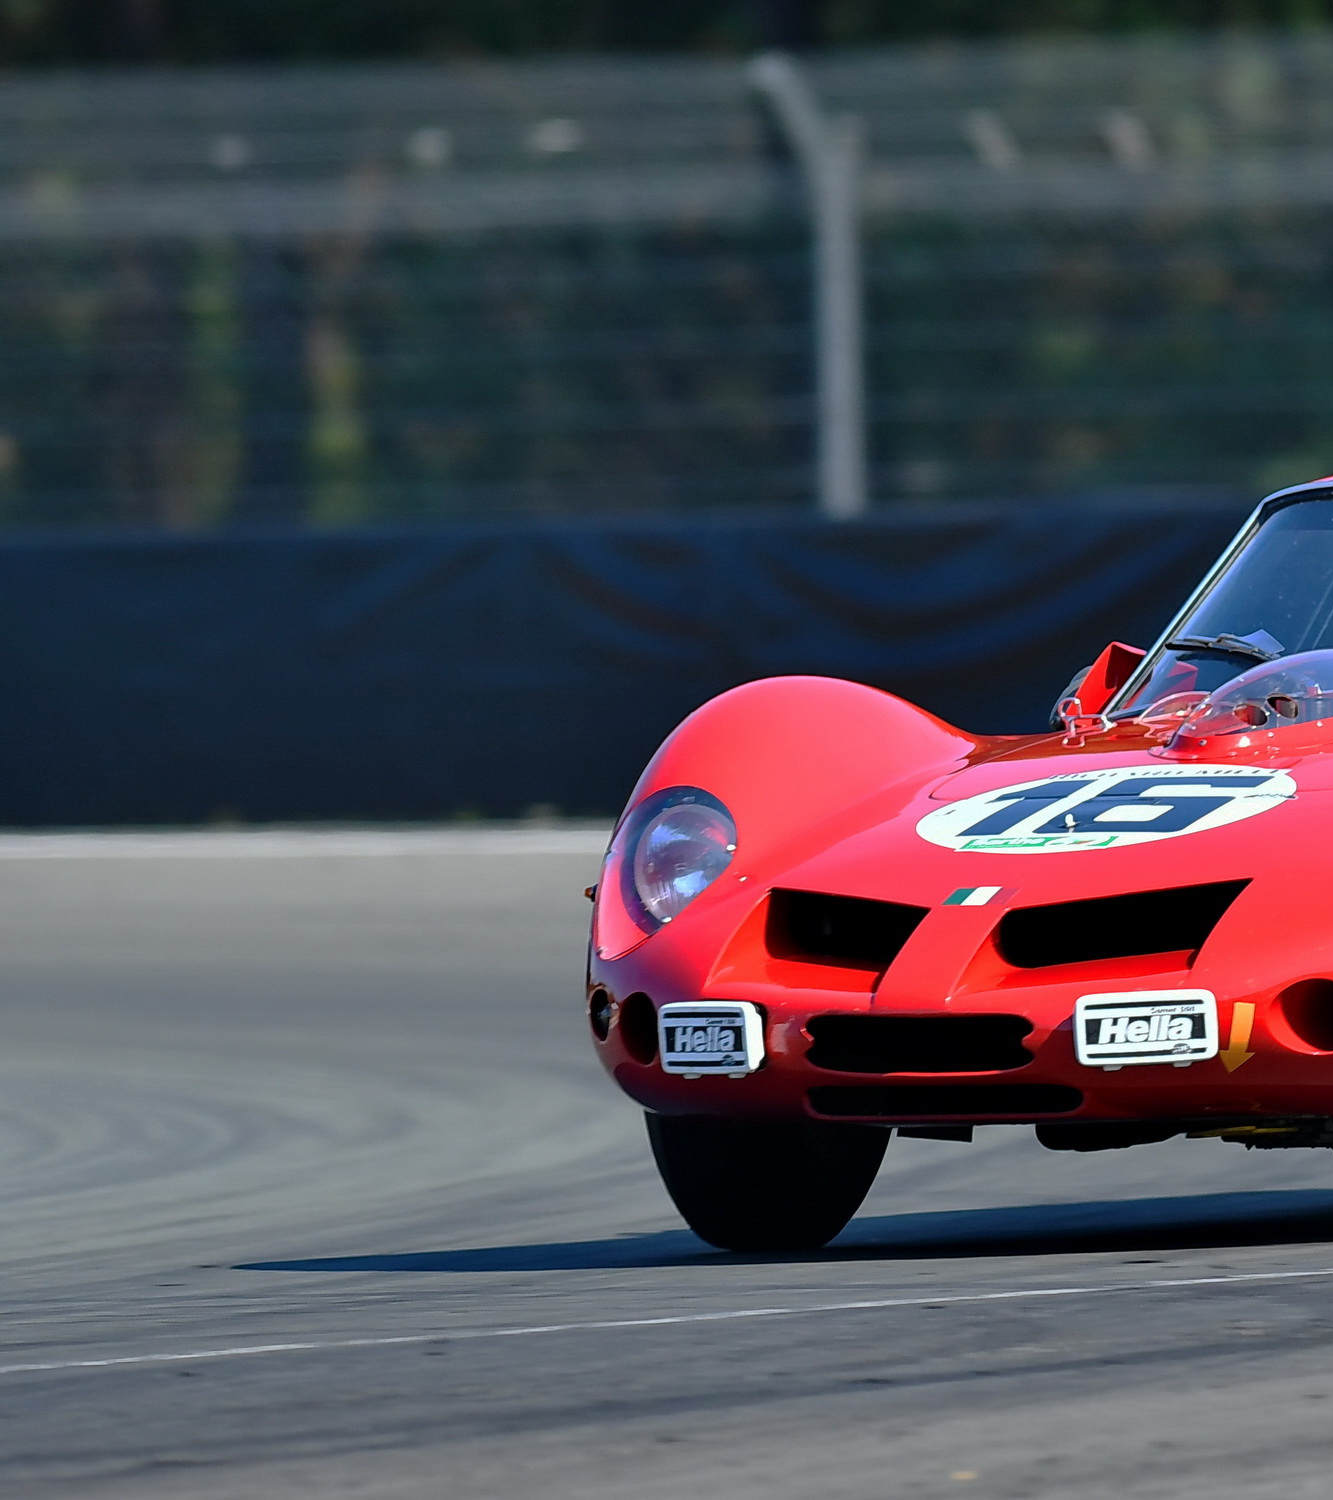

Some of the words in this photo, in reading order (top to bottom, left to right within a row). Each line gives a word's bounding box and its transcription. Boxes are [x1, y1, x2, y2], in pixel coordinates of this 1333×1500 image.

[954, 775, 1275, 837] 16
[674, 1026, 736, 1053] Hella
[1098, 1014, 1193, 1045] Hella
